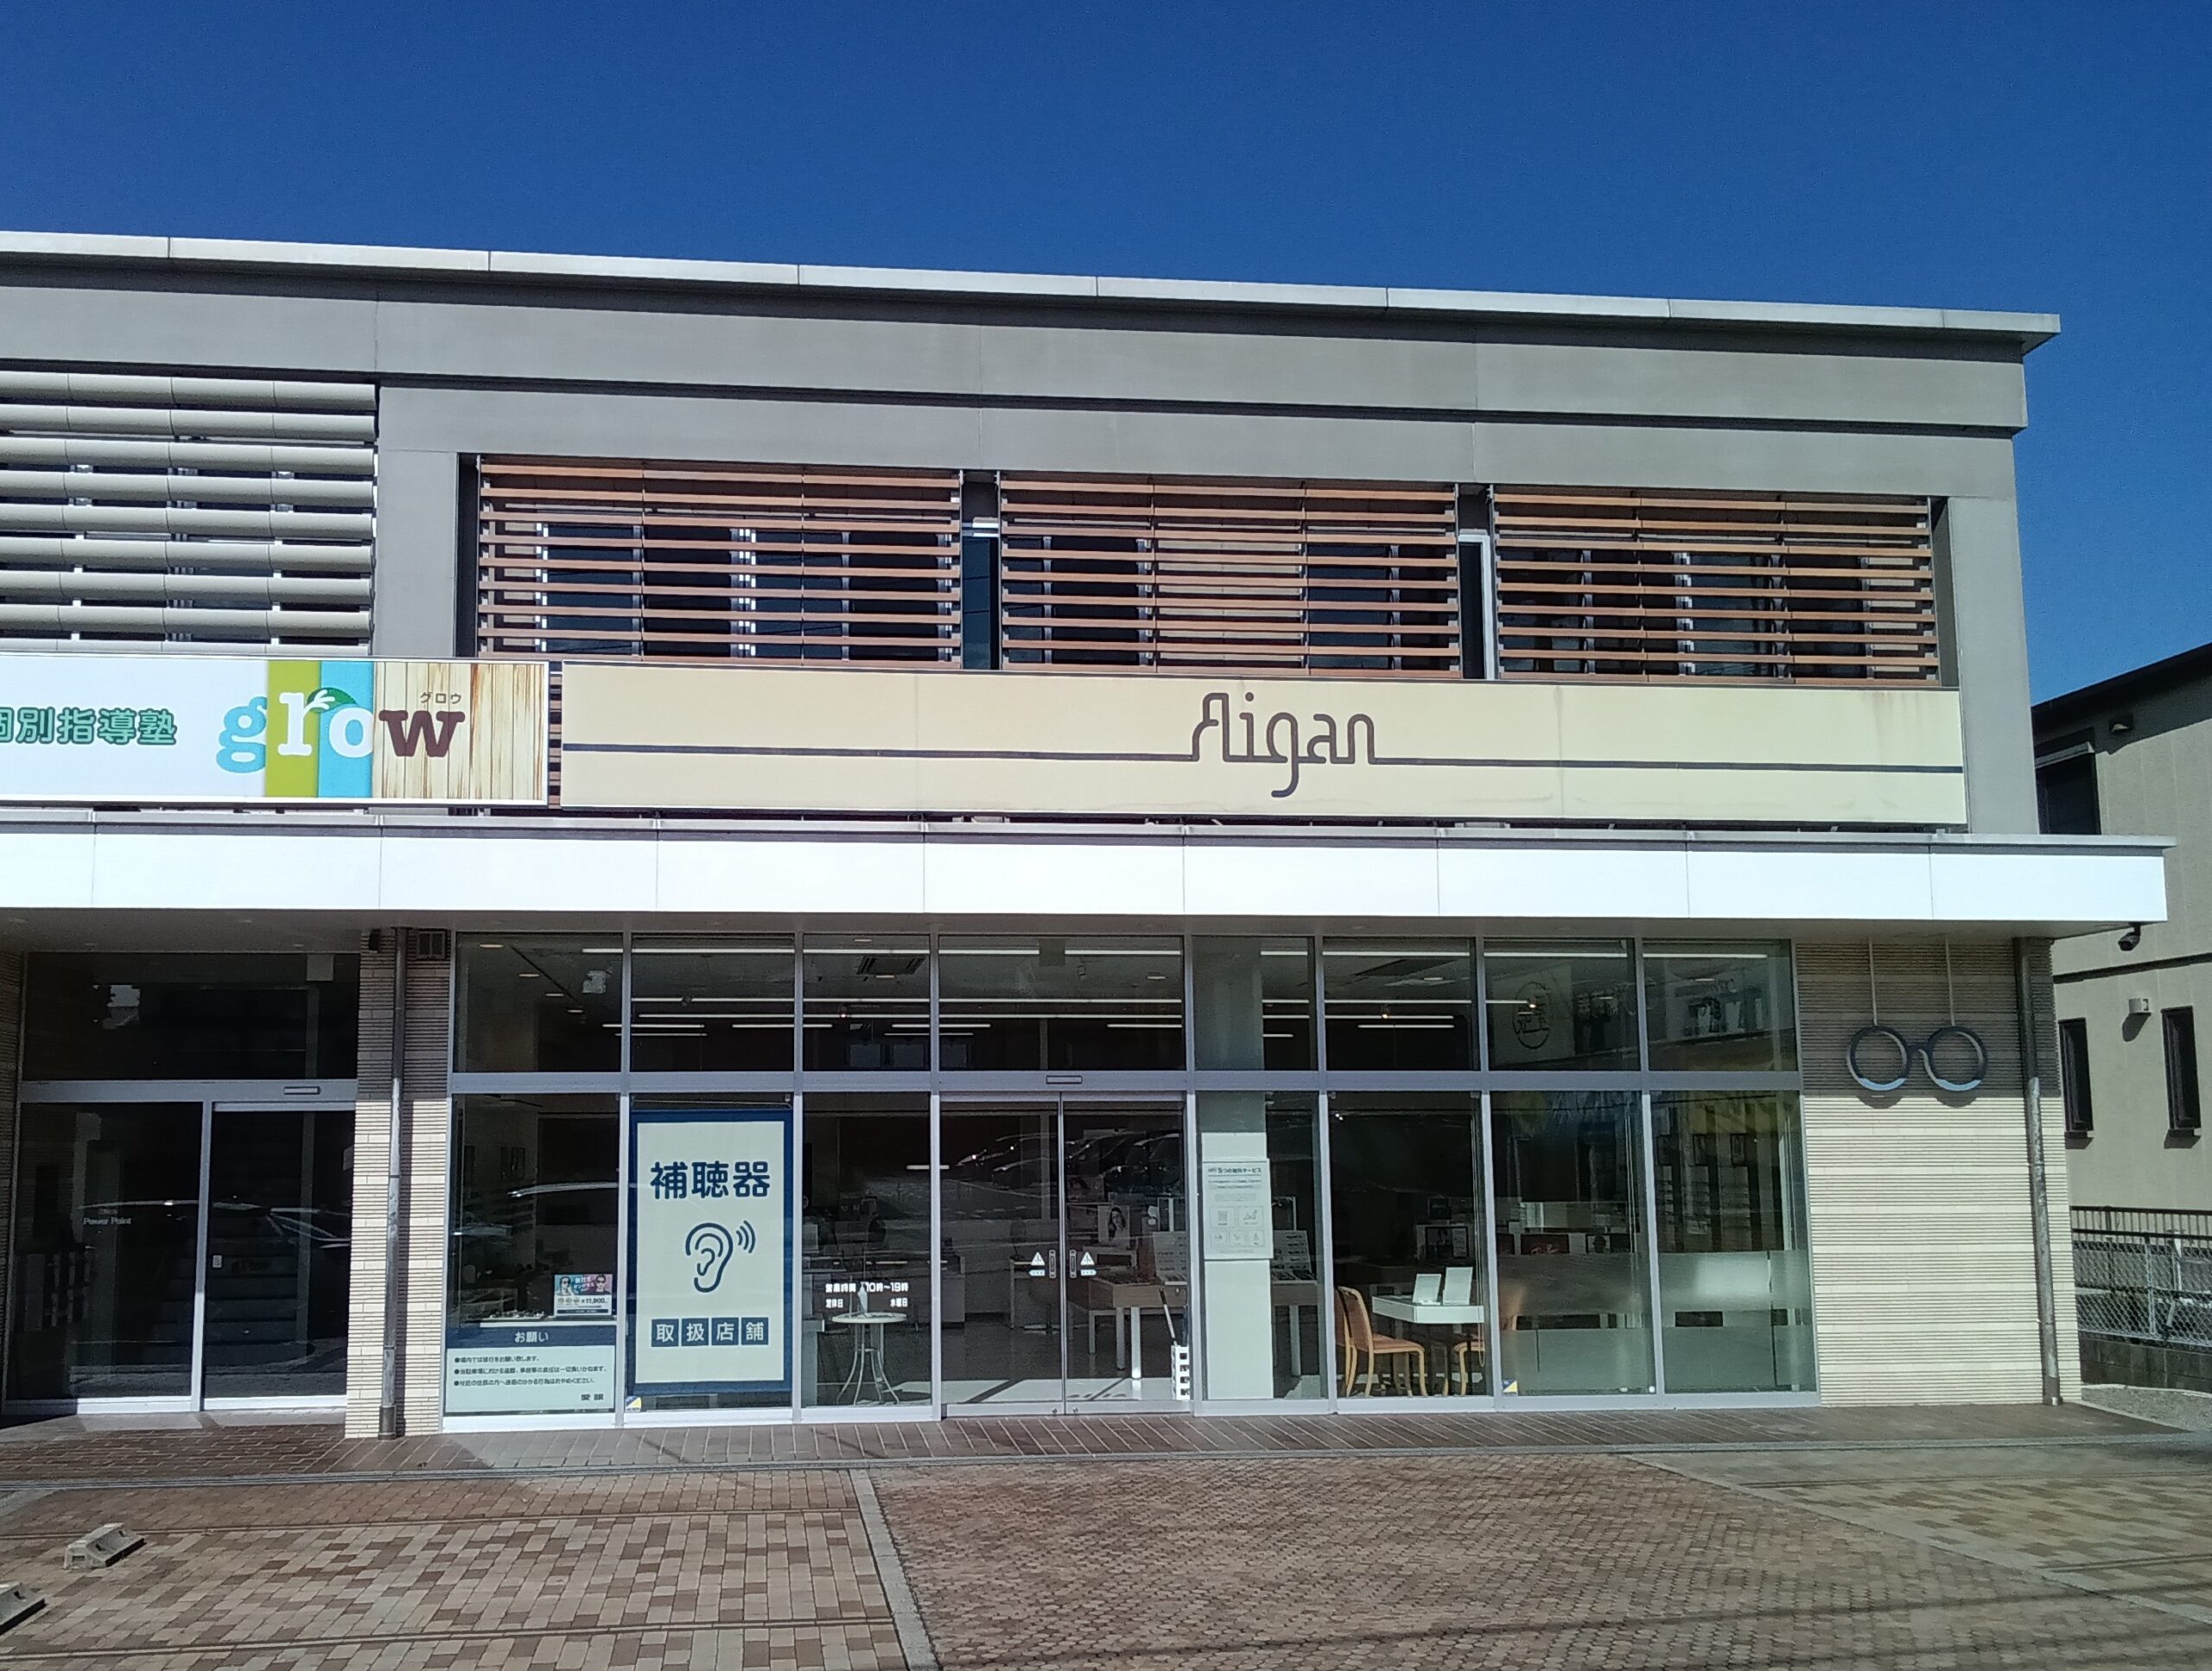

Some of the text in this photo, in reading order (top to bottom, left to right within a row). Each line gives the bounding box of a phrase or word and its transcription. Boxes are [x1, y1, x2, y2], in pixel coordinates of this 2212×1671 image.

[420, 691, 461, 704] グロウ
[1192, 691, 1375, 797] Aigan
[650, 1160, 770, 1199] 補聴器
[83, 1217, 109, 1225] Power
[825, 1299, 843, 1308] 定休日
[514, 1331, 549, 1344] お願い
[655, 1321, 765, 1344] 取扱店舗
